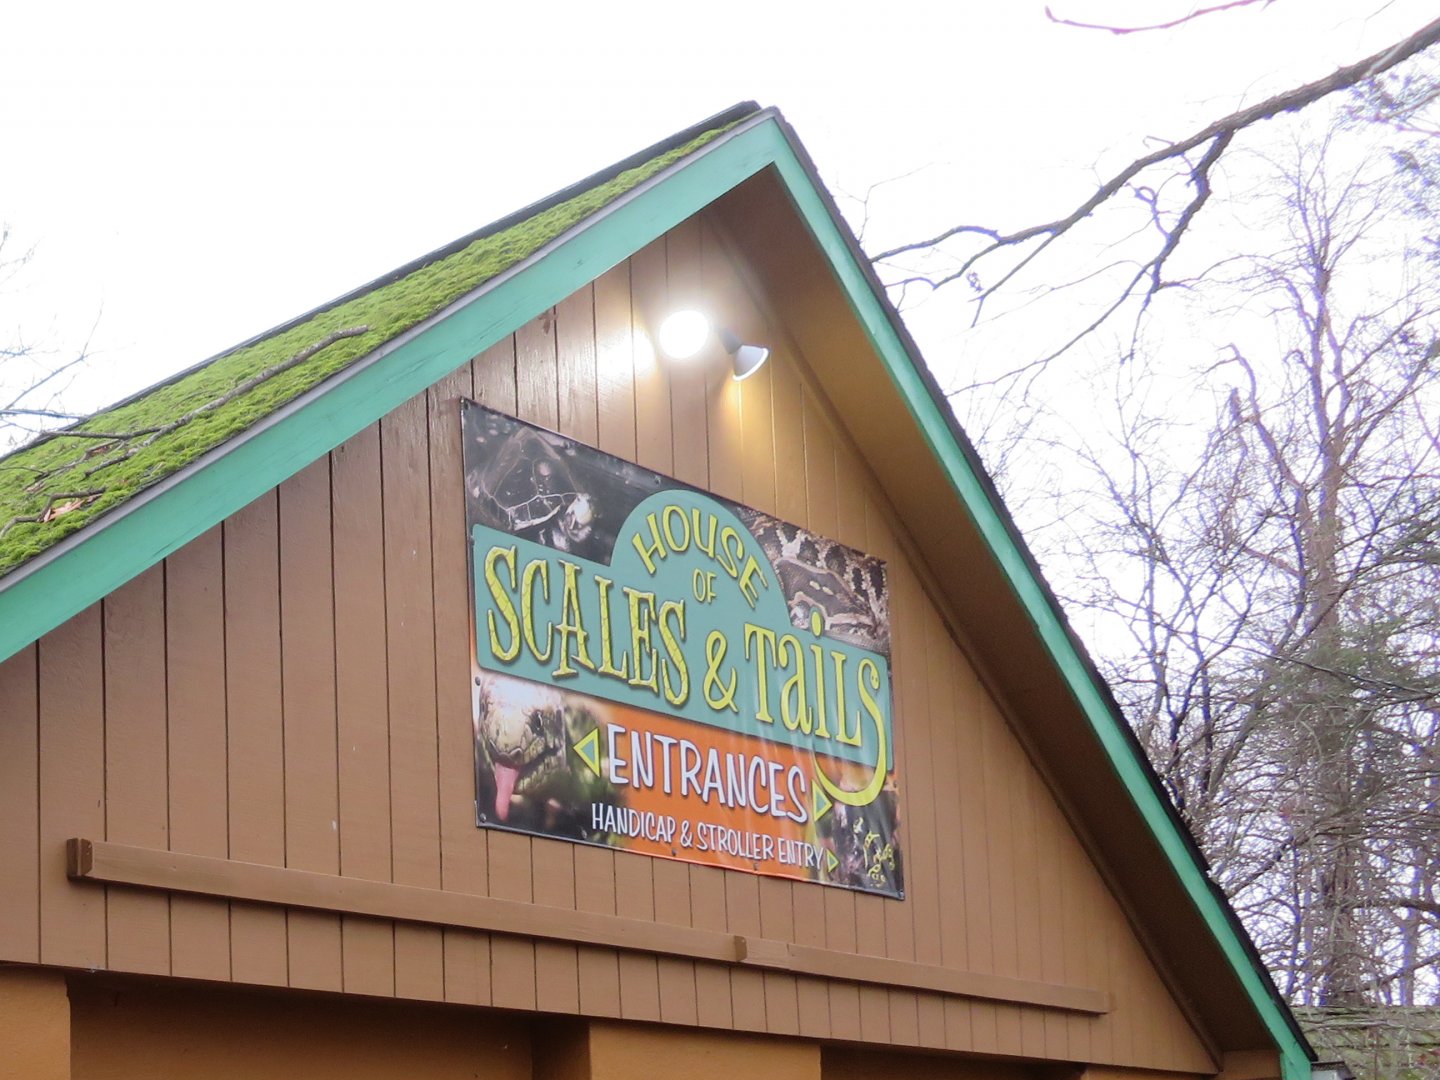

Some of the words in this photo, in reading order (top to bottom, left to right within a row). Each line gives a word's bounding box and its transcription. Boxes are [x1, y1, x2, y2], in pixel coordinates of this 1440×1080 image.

[632, 505, 768, 609] HOUSE
[691, 567, 718, 604] OF
[484, 545, 690, 707] SCALES
[703, 629, 739, 713] &
[607, 723, 808, 825] ENTRANCES
[591, 802, 676, 843] HANDICAP
[679, 819, 693, 848] &
[696, 821, 774, 861] STROLLER
[778, 837, 824, 871] ENTRY
